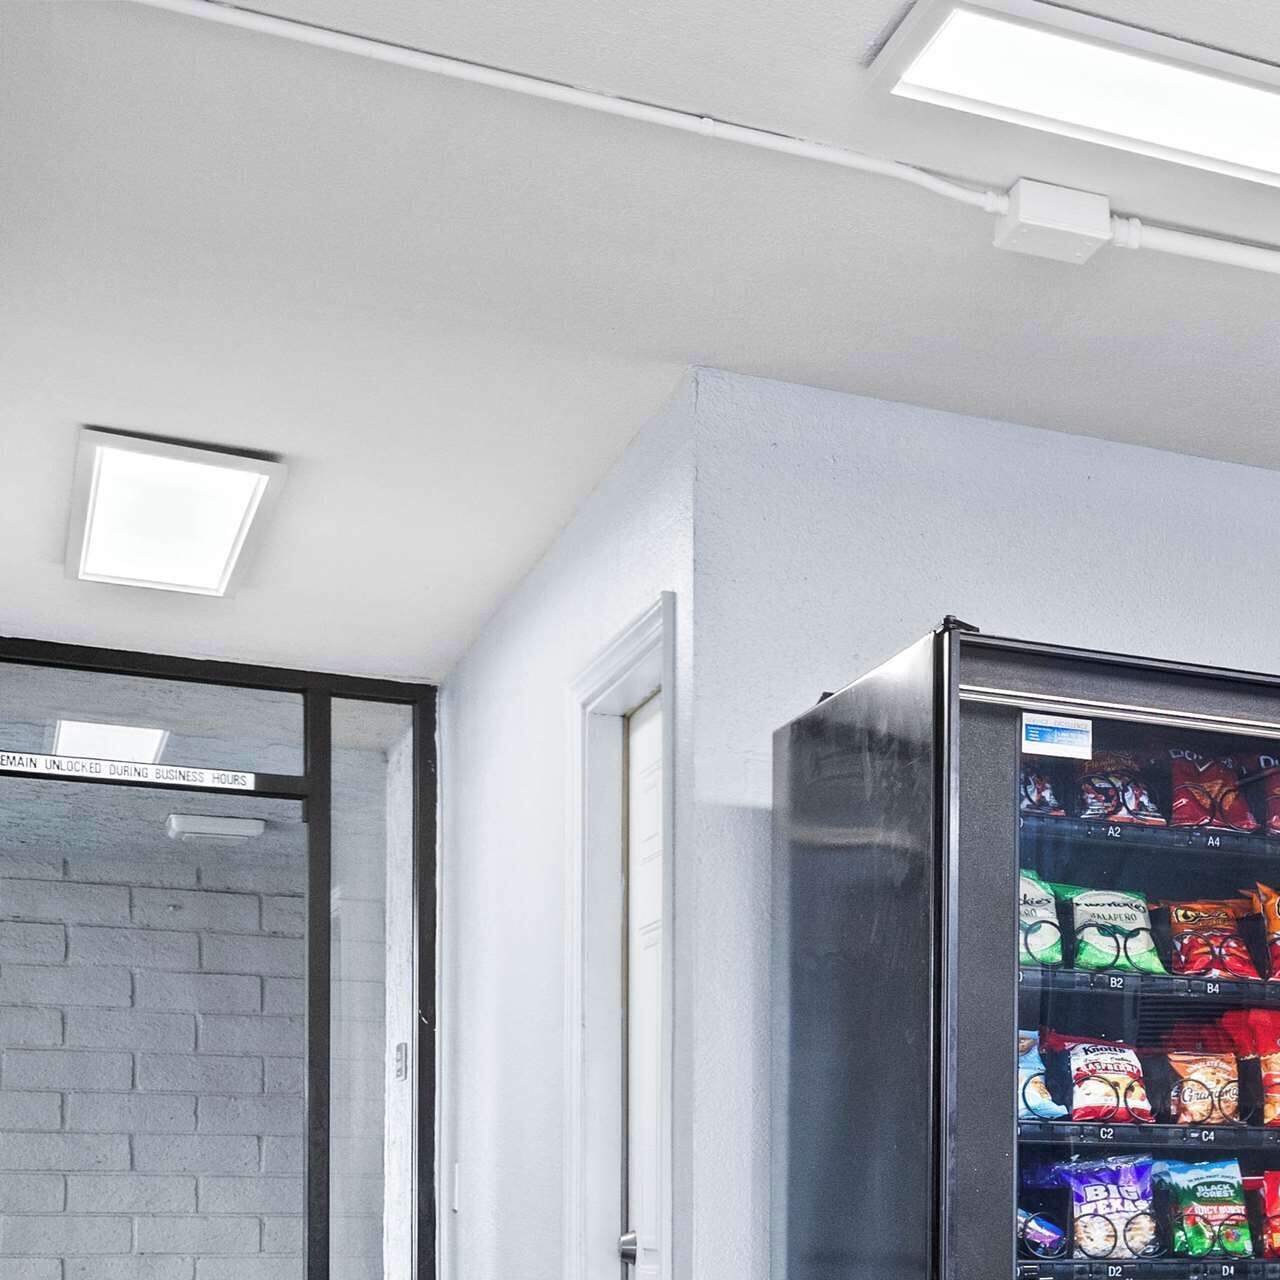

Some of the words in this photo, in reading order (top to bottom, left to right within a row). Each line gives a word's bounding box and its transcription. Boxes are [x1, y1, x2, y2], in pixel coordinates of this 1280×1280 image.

[44, 758, 102, 775] UNLOCKED
[108, 763, 149, 779] DURING
[155, 767, 205, 783] BUSINESS
[211, 772, 248, 787] HOURS
[1107, 826, 1121, 837] A2
[1207, 836, 1221, 847] A4
[1110, 977, 1124, 988] B2
[1206, 982, 1219, 994] B4
[1100, 1128, 1114, 1139] C2
[1202, 1131, 1215, 1141] C4
[1084, 1183, 1140, 1202] BIG
[1196, 1184, 1231, 1192] BLACK
[1196, 1190, 1235, 1198] FOREST
[1081, 1199, 1150, 1218] TEXAS
[1108, 1266, 1122, 1277] D2
[1222, 1266, 1234, 1276] D4
